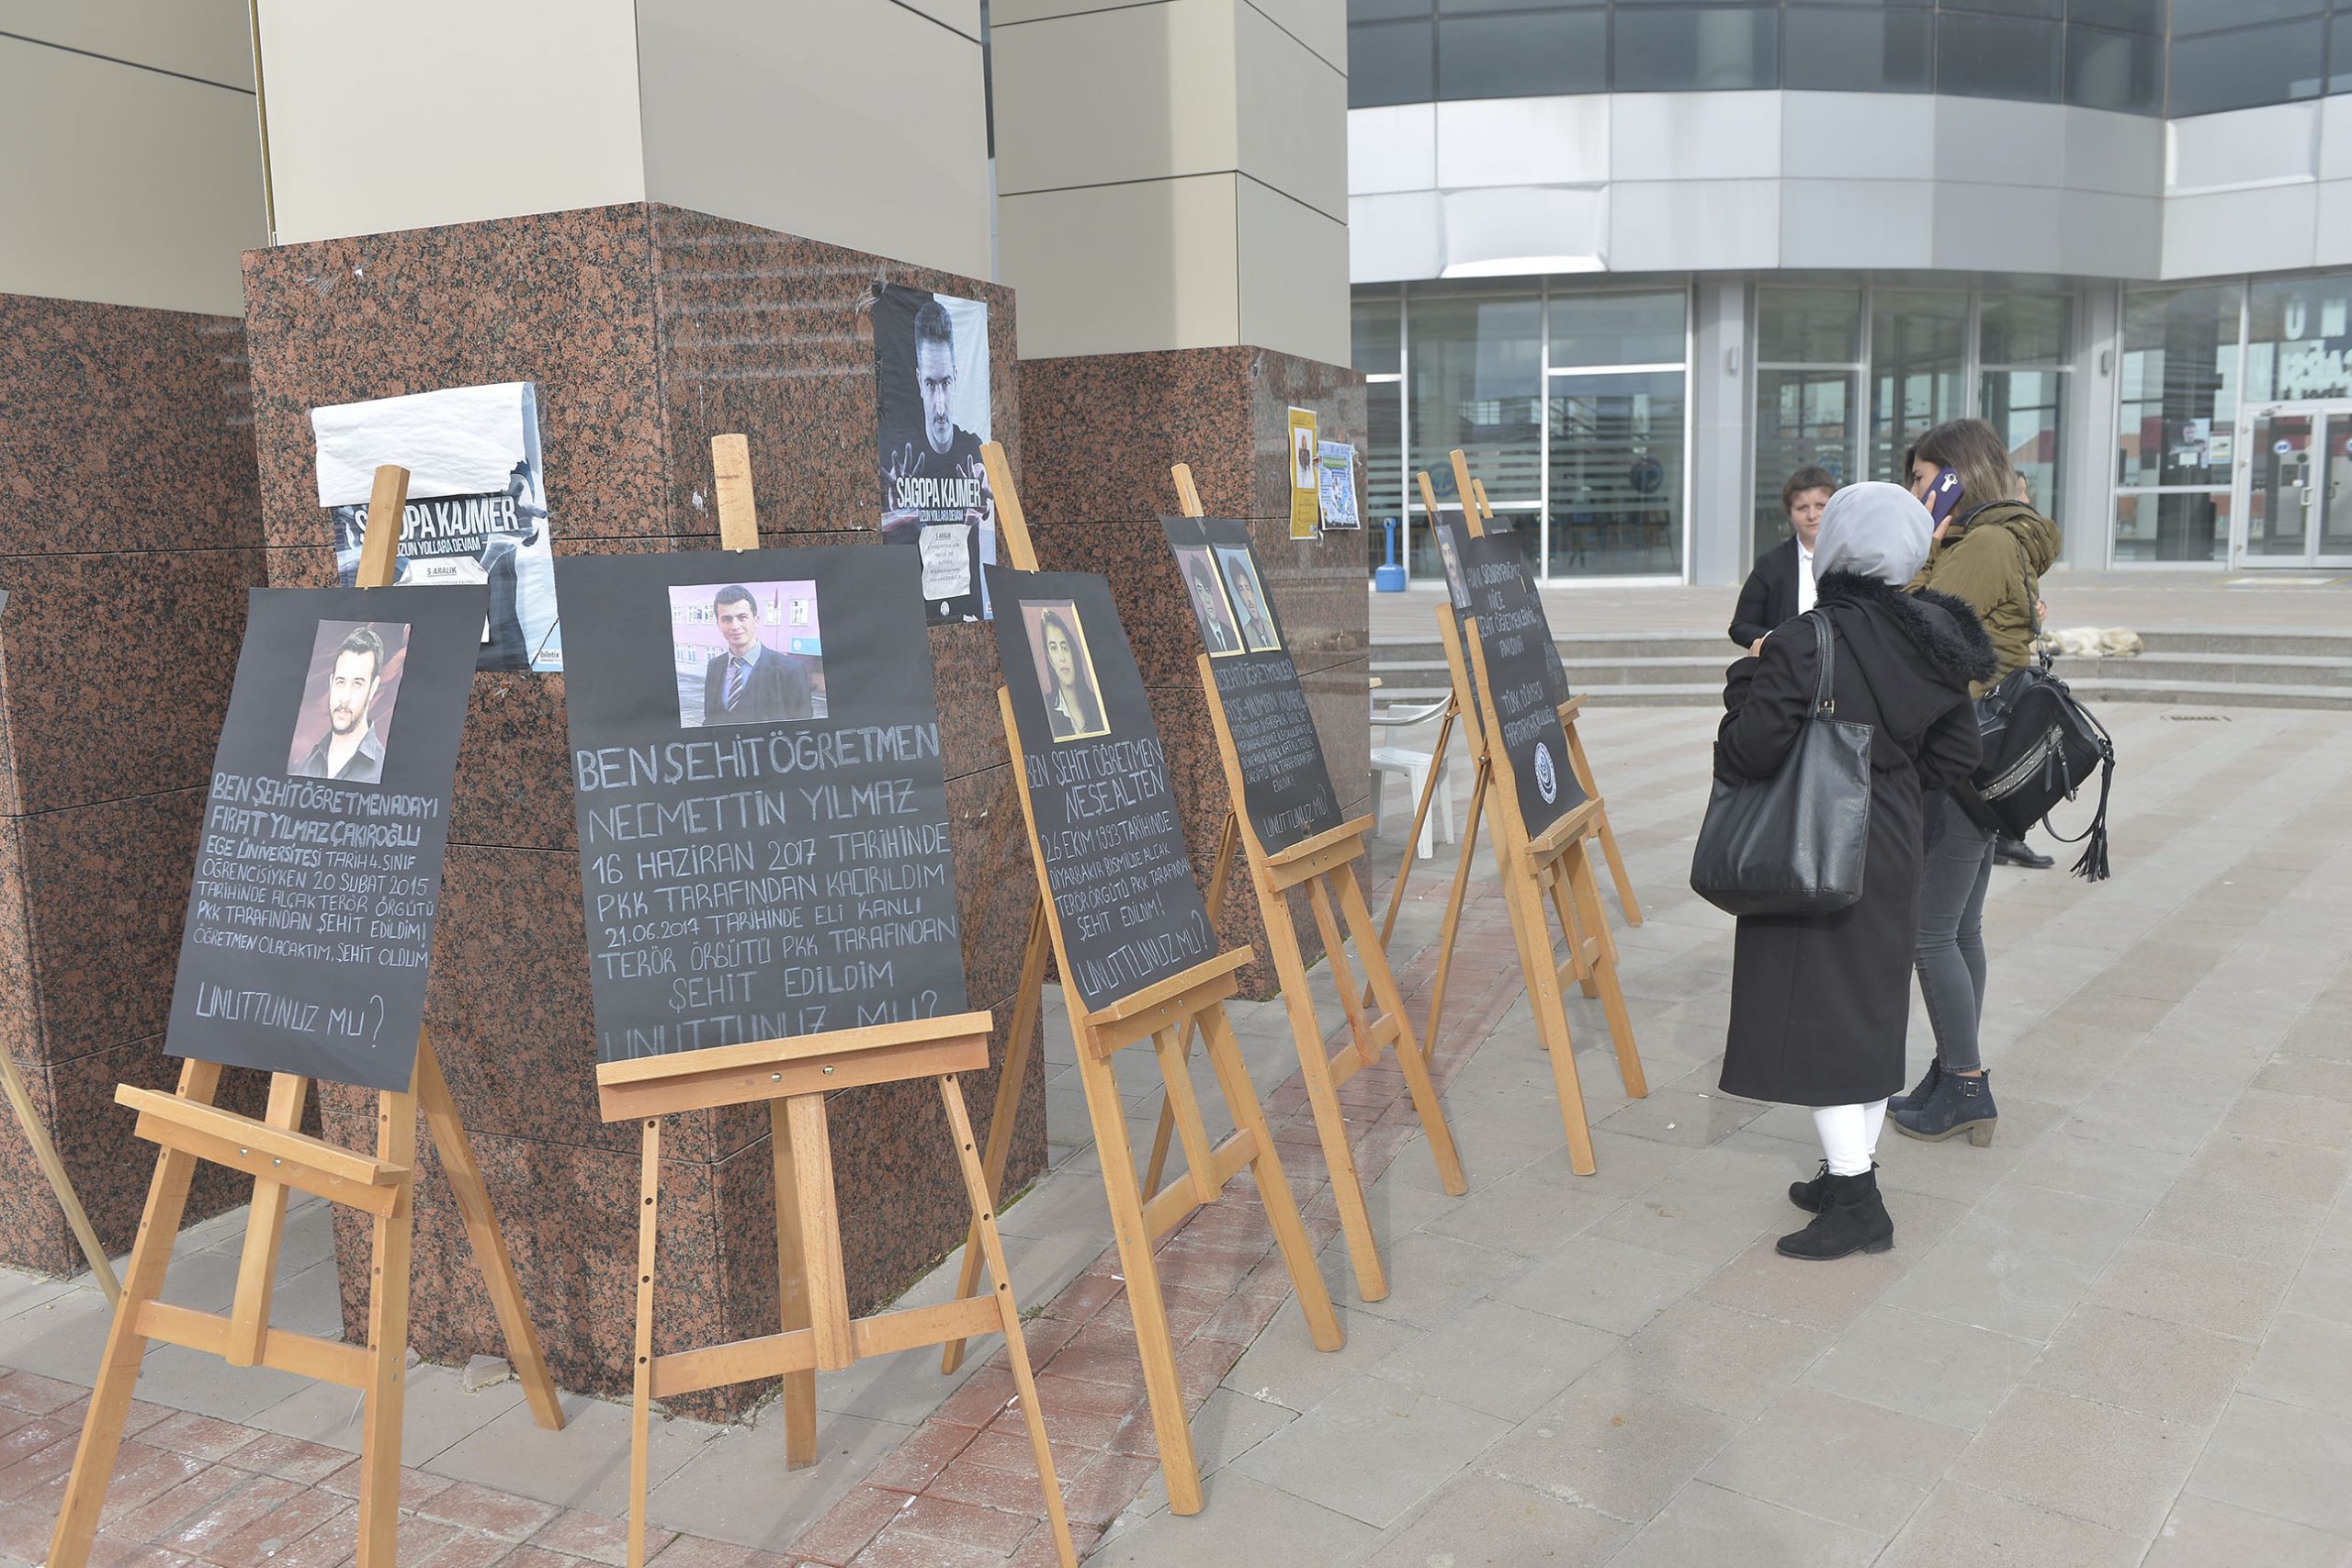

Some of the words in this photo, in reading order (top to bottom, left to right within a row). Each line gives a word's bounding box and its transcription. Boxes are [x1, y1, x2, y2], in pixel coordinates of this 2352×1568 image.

[896, 477, 940, 508] SAGOPA
[940, 478, 981, 508] KAJMER
[354, 502, 436, 543] SOPA
[435, 495, 520, 537] KAJMER
[418, 538, 454, 556] YOLLARA
[452, 536, 481, 553] DEVAM
[432, 566, 457, 575] ARALIK
[577, 744, 658, 793] BEN
[663, 734, 764, 786] ŞEHİT
[769, 722, 940, 774] ÖĞRETMEN
[1024, 754, 1050, 789] BEN
[1051, 749, 1091, 787] ŞEHİT
[1091, 737, 1165, 777] ÖĞRETMEN
[211, 772, 252, 802] BEN
[252, 776, 302, 807] ŞEHİT
[299, 780, 390, 818] ÖĞRETMEN
[390, 795, 438, 819] ADAYI
[588, 790, 786, 844] NECMETTİN
[798, 779, 920, 821] YILMAZ
[1066, 781, 1115, 824] NEŞE
[1112, 765, 1165, 809] ALTEN
[210, 806, 269, 837] FIRAT
[270, 812, 331, 843] YILMAZ
[331, 820, 421, 849] ÇAKIROĞLU
[1042, 831, 1063, 863] 26
[1061, 826, 1096, 860] EKİM
[1095, 823, 1122, 851] 1993
[1117, 810, 1173, 842] TARİHİNDE
[202, 854, 308, 888] ÖĞRENCİSİYKEN
[312, 871, 335, 890] 20
[339, 873, 388, 894] ŞUBAT
[389, 875, 430, 897] 2015
[206, 834, 236, 857] EGE
[236, 837, 323, 867] ÜNİVERSİTESİ
[325, 851, 368, 871] TARİH
[369, 853, 382, 869] 4.
[382, 853, 416, 872] SINIF
[592, 852, 623, 885] 16
[637, 840, 754, 881] HAZİRAN
[768, 838, 817, 871] 2017
[829, 822, 952, 863] TARİHİNDE
[1049, 861, 1105, 891] DİYARBAKIR
[197, 881, 267, 903] TARİHİNDE
[271, 890, 316, 909] ALÇAK
[597, 891, 649, 923] PKK
[653, 874, 818, 913] TARAFINDAN
[827, 863, 945, 897] KAÇIRILDIM
[1055, 890, 1090, 919] TERÖR
[1089, 877, 1129, 909] ÖRGÜTÜ
[1130, 875, 1149, 895] PKK
[1148, 855, 1192, 887] TARAFINDAN
[197, 899, 221, 921] PKK
[225, 905, 313, 931] TARAFINDAN
[316, 912, 366, 935] ŞEHİT
[605, 917, 701, 949] 21.06.2017
[705, 905, 804, 935] TARİHİNDE
[815, 904, 844, 926] ELİ
[858, 897, 922, 921] KANLI
[1077, 909, 1111, 942] ŞEHİT
[193, 922, 258, 951] ÖĞRETMEN
[336, 942, 375, 963] ŞEHİT
[379, 947, 428, 969] OLDUM
[598, 944, 677, 980] TERÖR
[691, 936, 771, 972] ÖRGÜTÜ
[783, 934, 818, 959] PKK
[828, 915, 956, 954] TARAFINDAN
[1078, 932, 1181, 997] UNUTTUNUZ
[195, 980, 320, 1032] UNUTTUNUZ
[669, 969, 758, 1012] ŞEHİT
[784, 960, 895, 998] EDİLDİM
